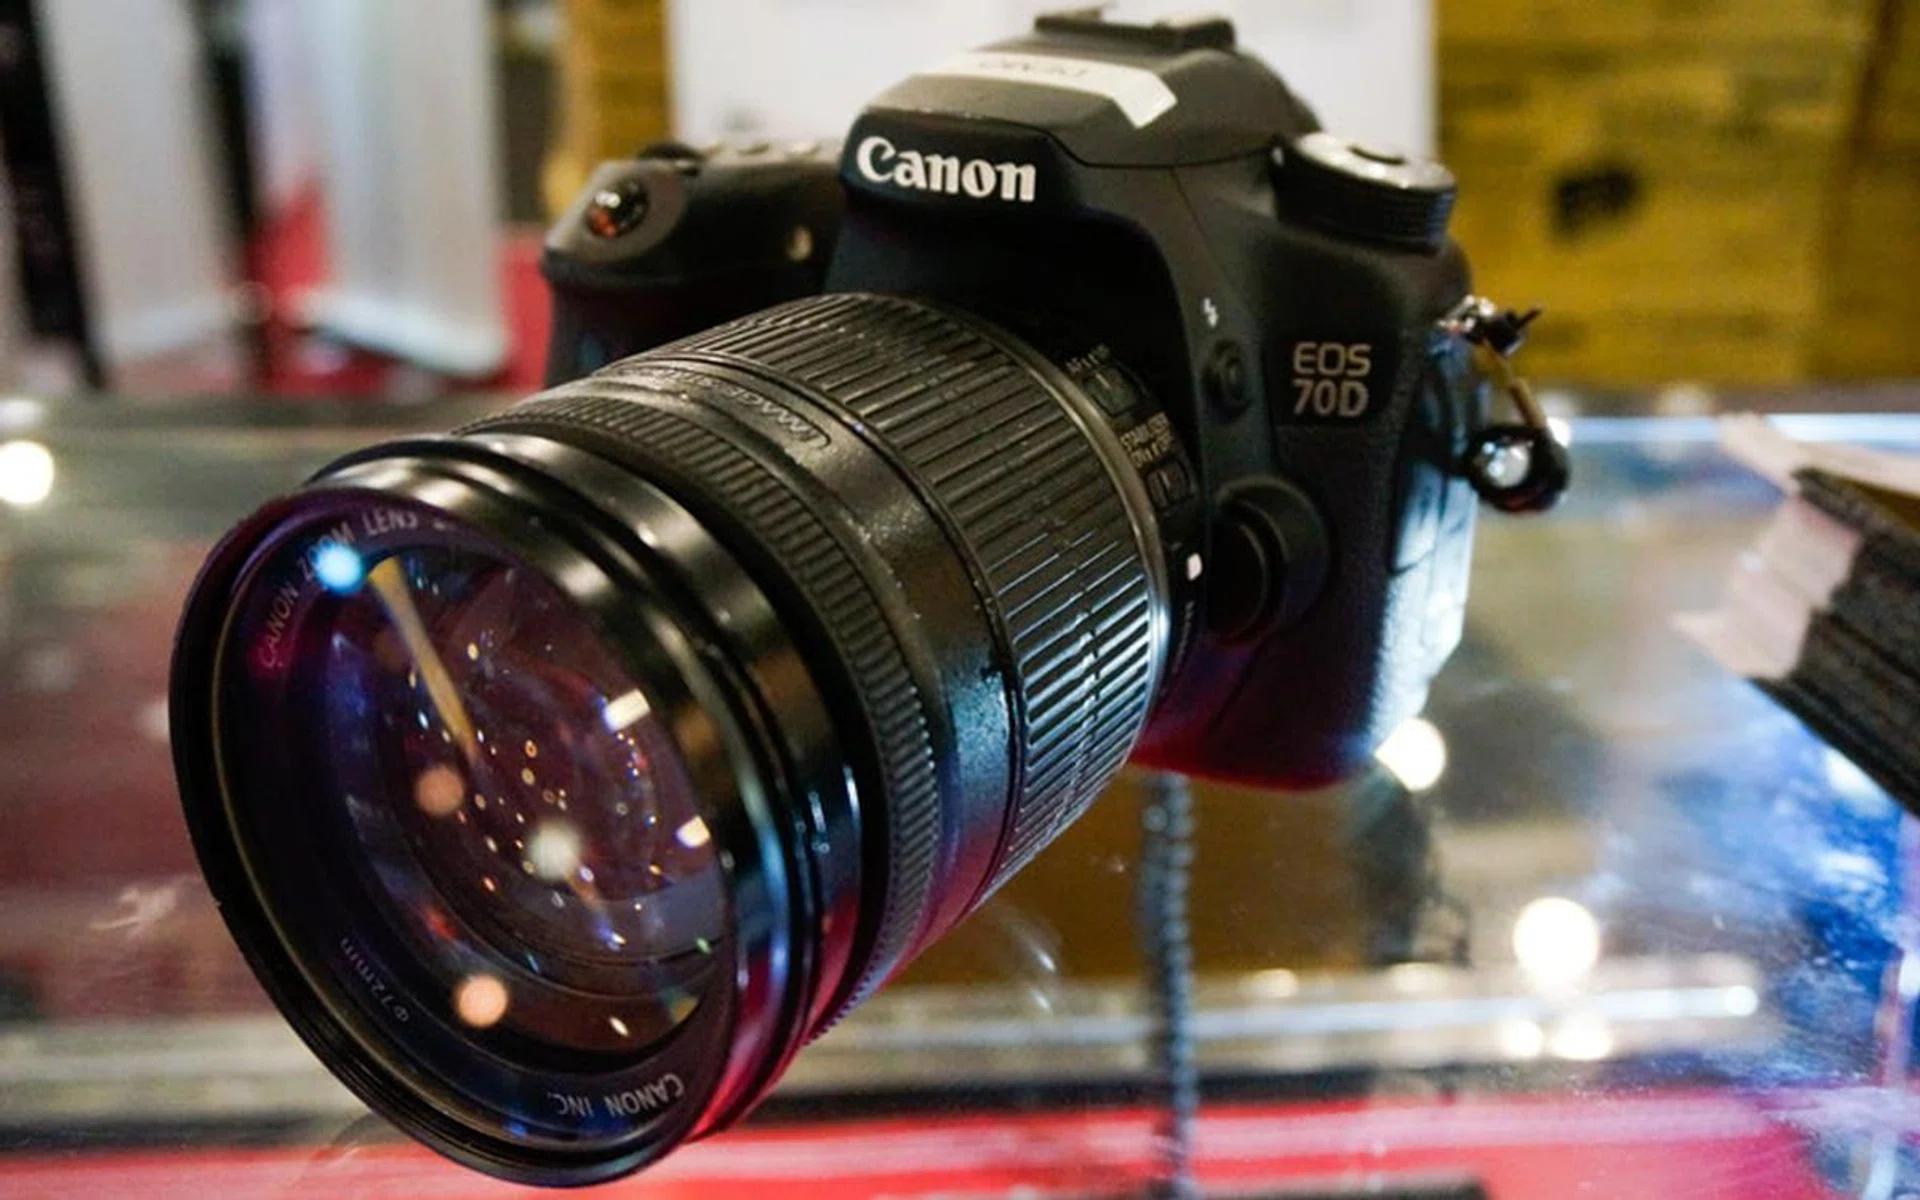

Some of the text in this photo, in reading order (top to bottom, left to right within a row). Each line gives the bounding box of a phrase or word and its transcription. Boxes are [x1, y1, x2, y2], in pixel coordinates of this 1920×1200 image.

[856, 136, 1037, 203] Canon
[1292, 341, 1372, 378] EOS
[1291, 379, 1369, 419] 70D
[604, 1072, 686, 1118] CANON
